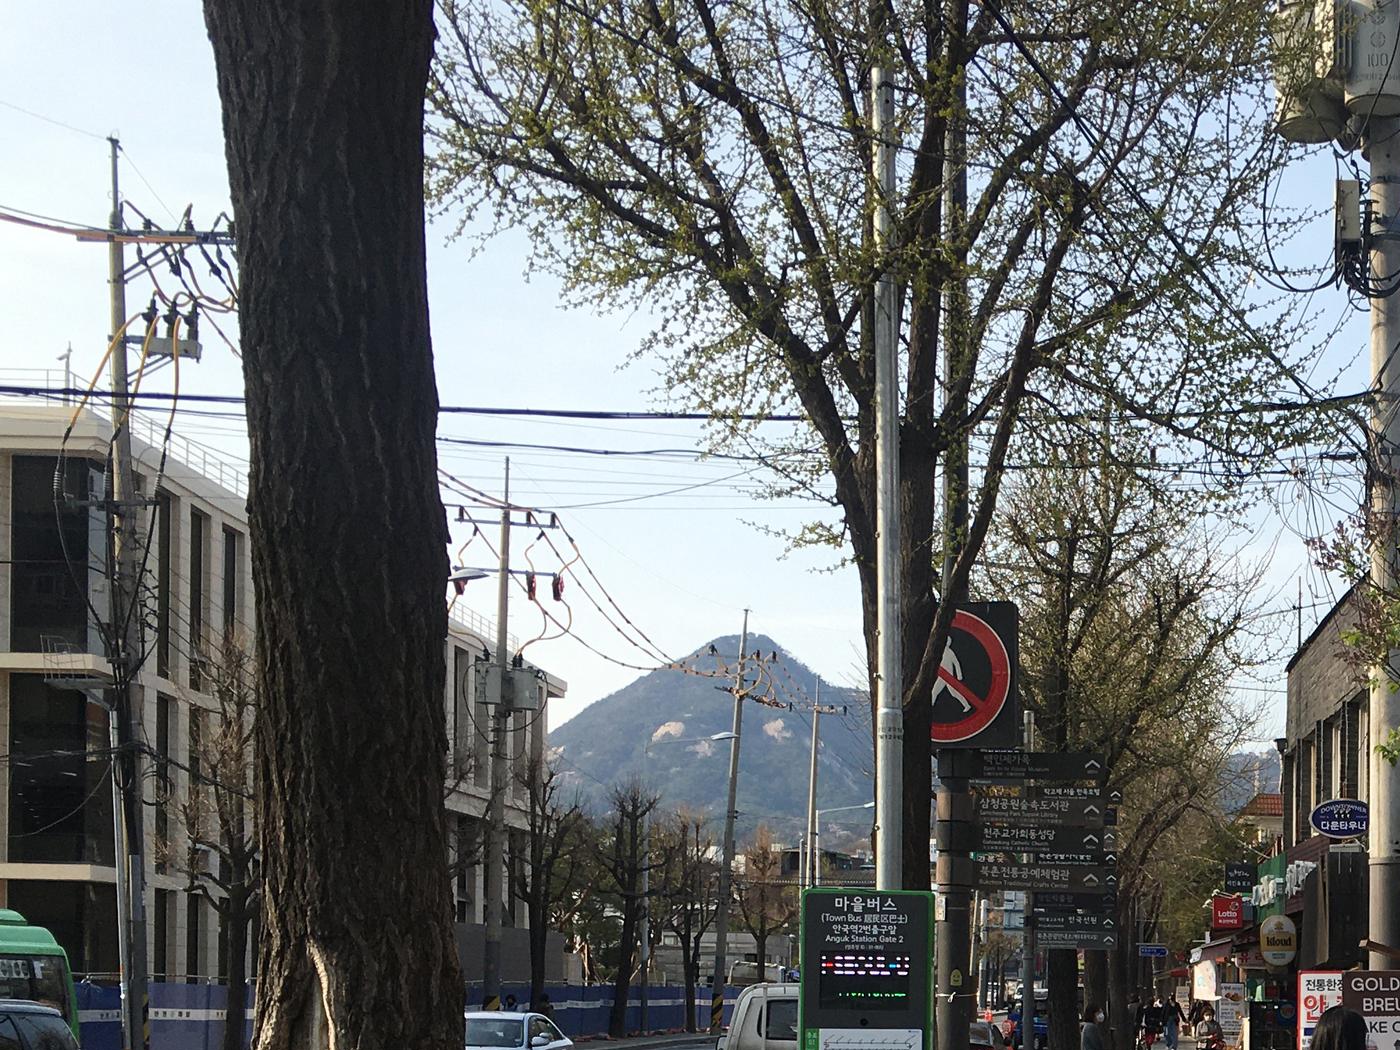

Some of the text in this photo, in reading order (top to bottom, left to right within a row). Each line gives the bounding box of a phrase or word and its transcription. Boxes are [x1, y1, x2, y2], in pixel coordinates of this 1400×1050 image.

[1321, 820, 1367, 831] 다운타우너
[834, 896, 897, 912] 마을버스
[848, 914, 862, 922] Bus
[1217, 910, 1238, 918] Lotto
[825, 934, 904, 943] Anguk Station Gate 2
